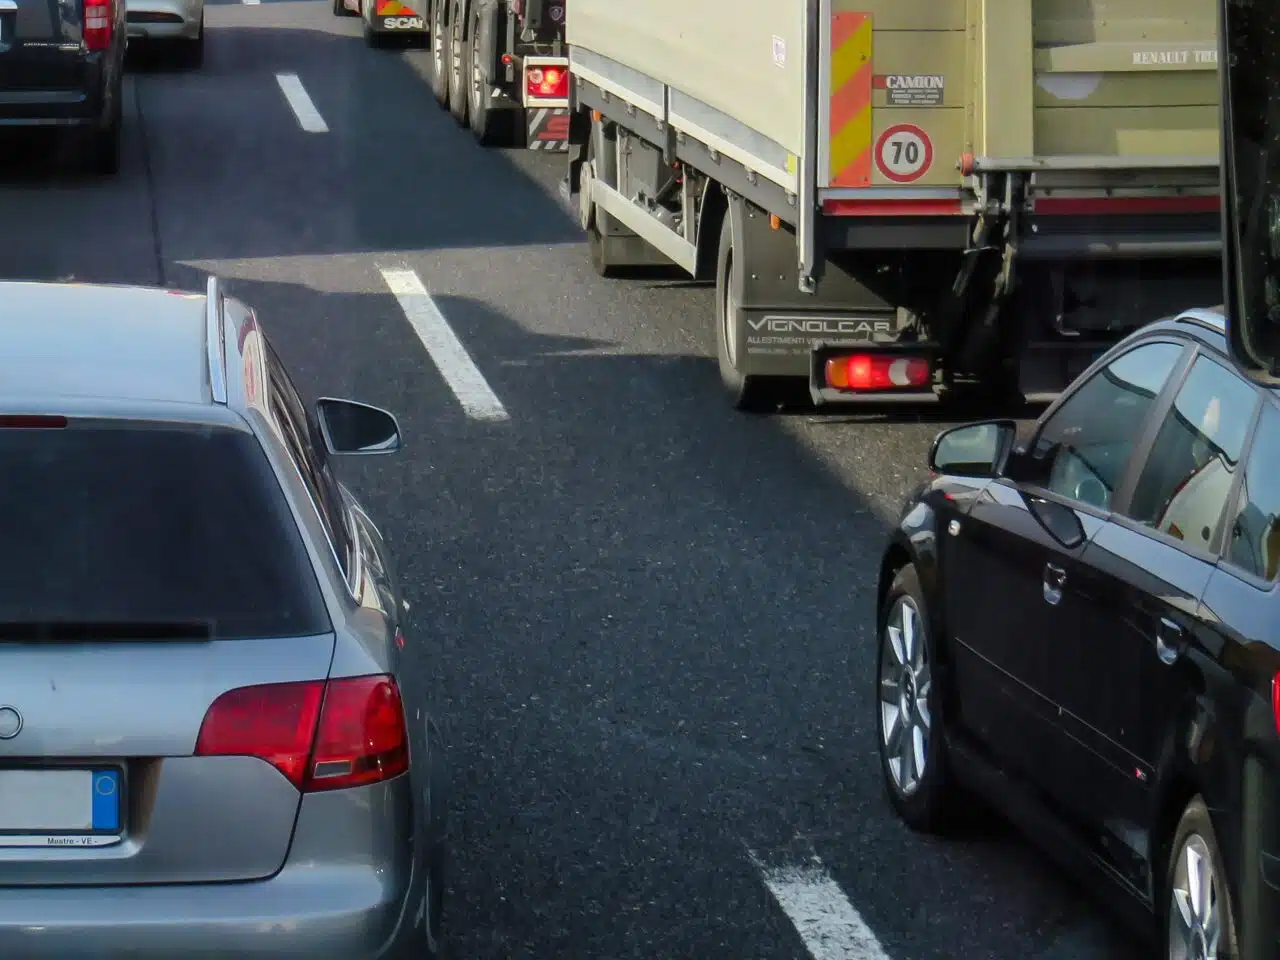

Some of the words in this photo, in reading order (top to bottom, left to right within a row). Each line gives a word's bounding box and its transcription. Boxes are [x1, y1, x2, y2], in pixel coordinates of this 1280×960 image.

[1132, 50, 1189, 64] RENAULT
[886, 75, 944, 89] CAMION
[891, 141, 919, 165] 70
[747, 315, 891, 332] VIGNOLCAR
